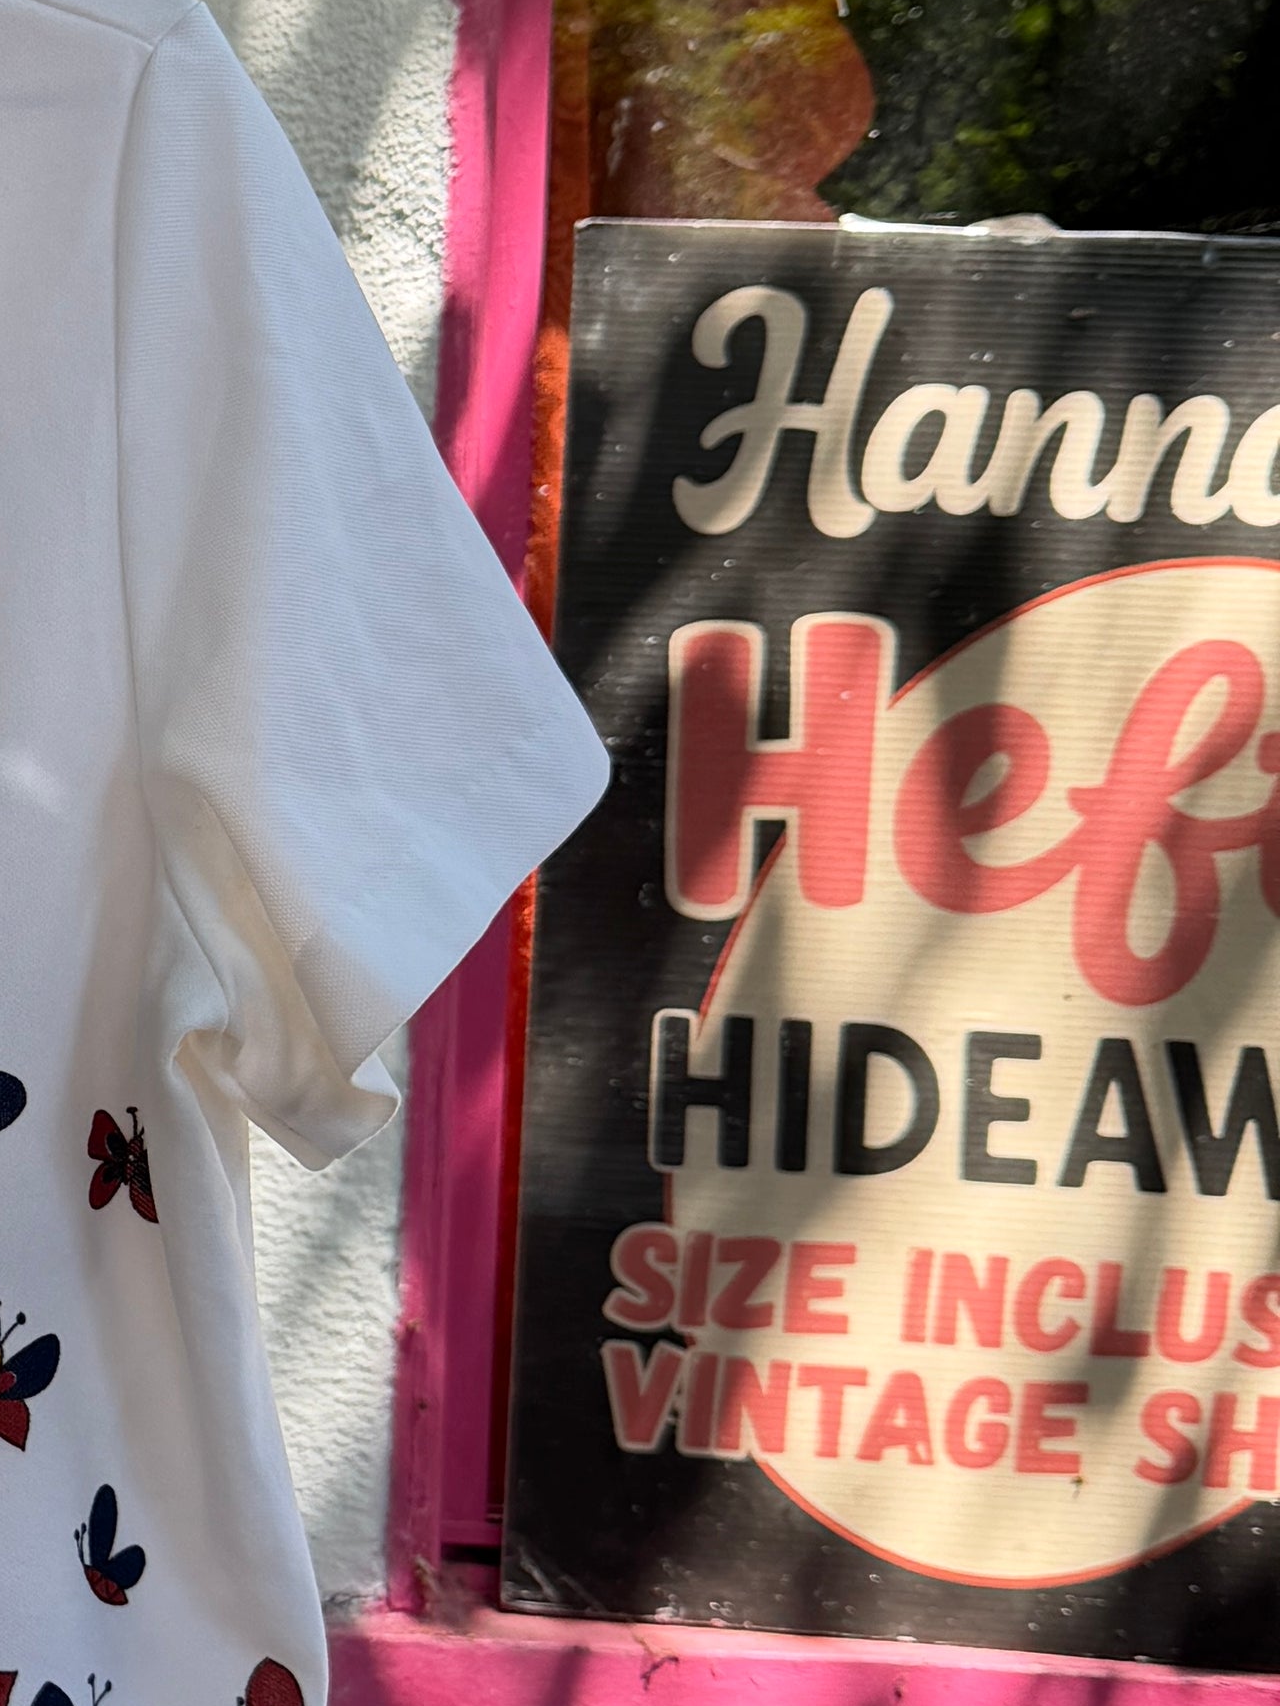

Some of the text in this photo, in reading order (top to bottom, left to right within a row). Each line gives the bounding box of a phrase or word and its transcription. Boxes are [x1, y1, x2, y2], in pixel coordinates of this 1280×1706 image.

[602, 1223, 859, 1335] SIZE
[601, 1339, 1280, 1492] VINTAGE SH
